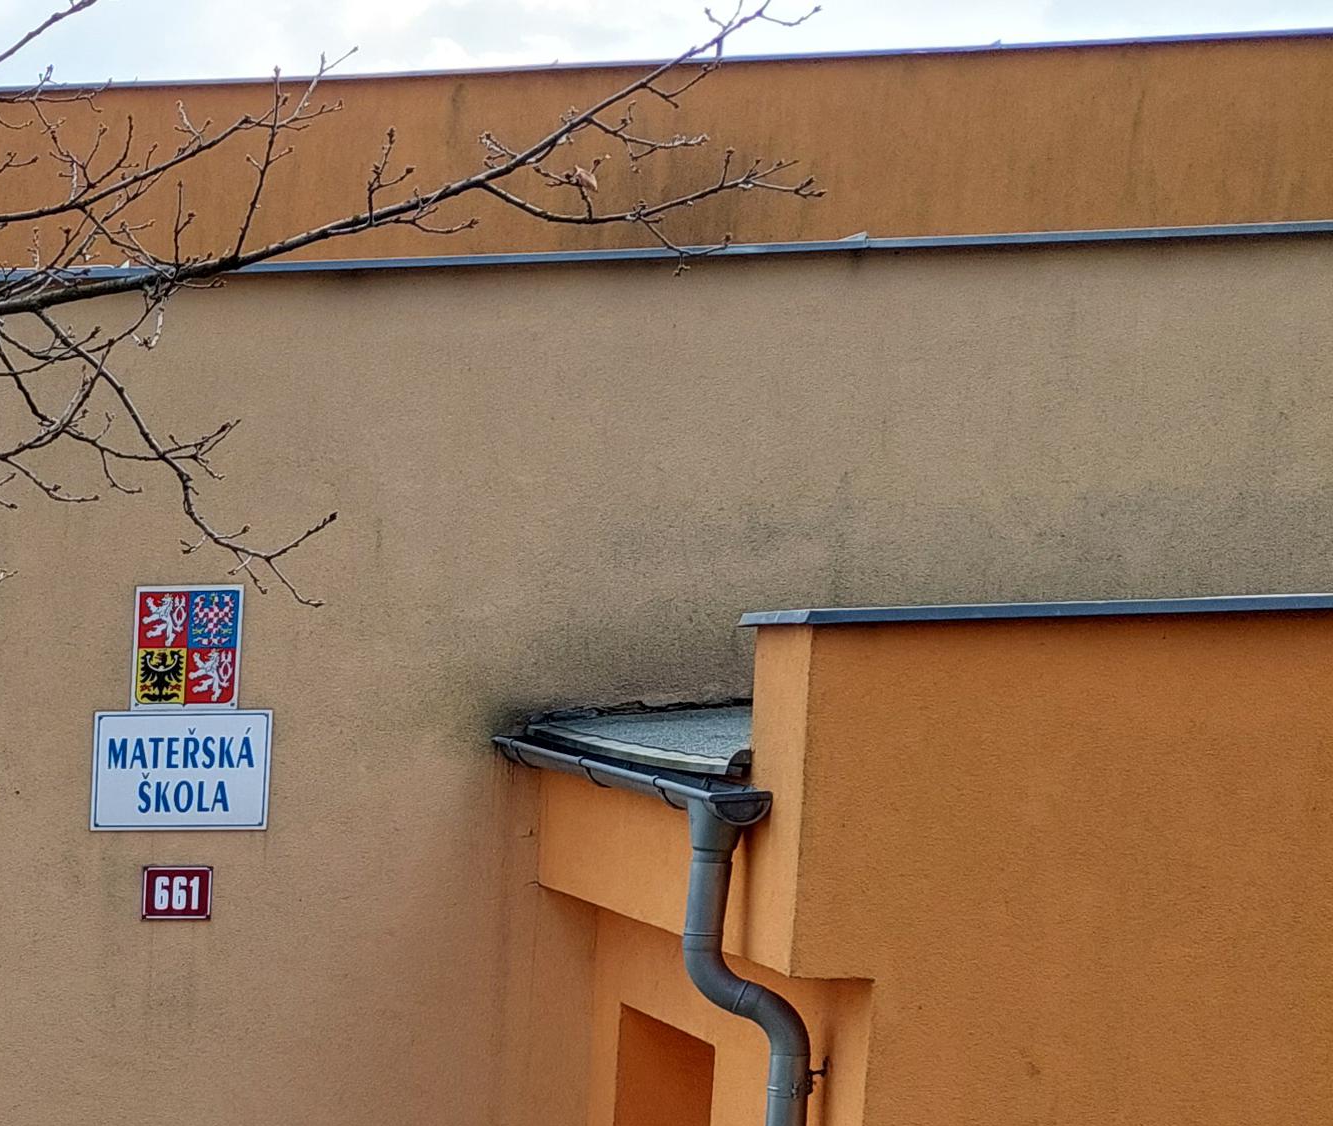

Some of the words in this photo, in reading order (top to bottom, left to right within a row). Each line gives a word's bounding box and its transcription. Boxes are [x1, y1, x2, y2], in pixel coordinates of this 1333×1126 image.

[108, 727, 254, 769] MATEŘSKÁ
[138, 772, 229, 813] ŠKOLA
[154, 876, 200, 910] 661
